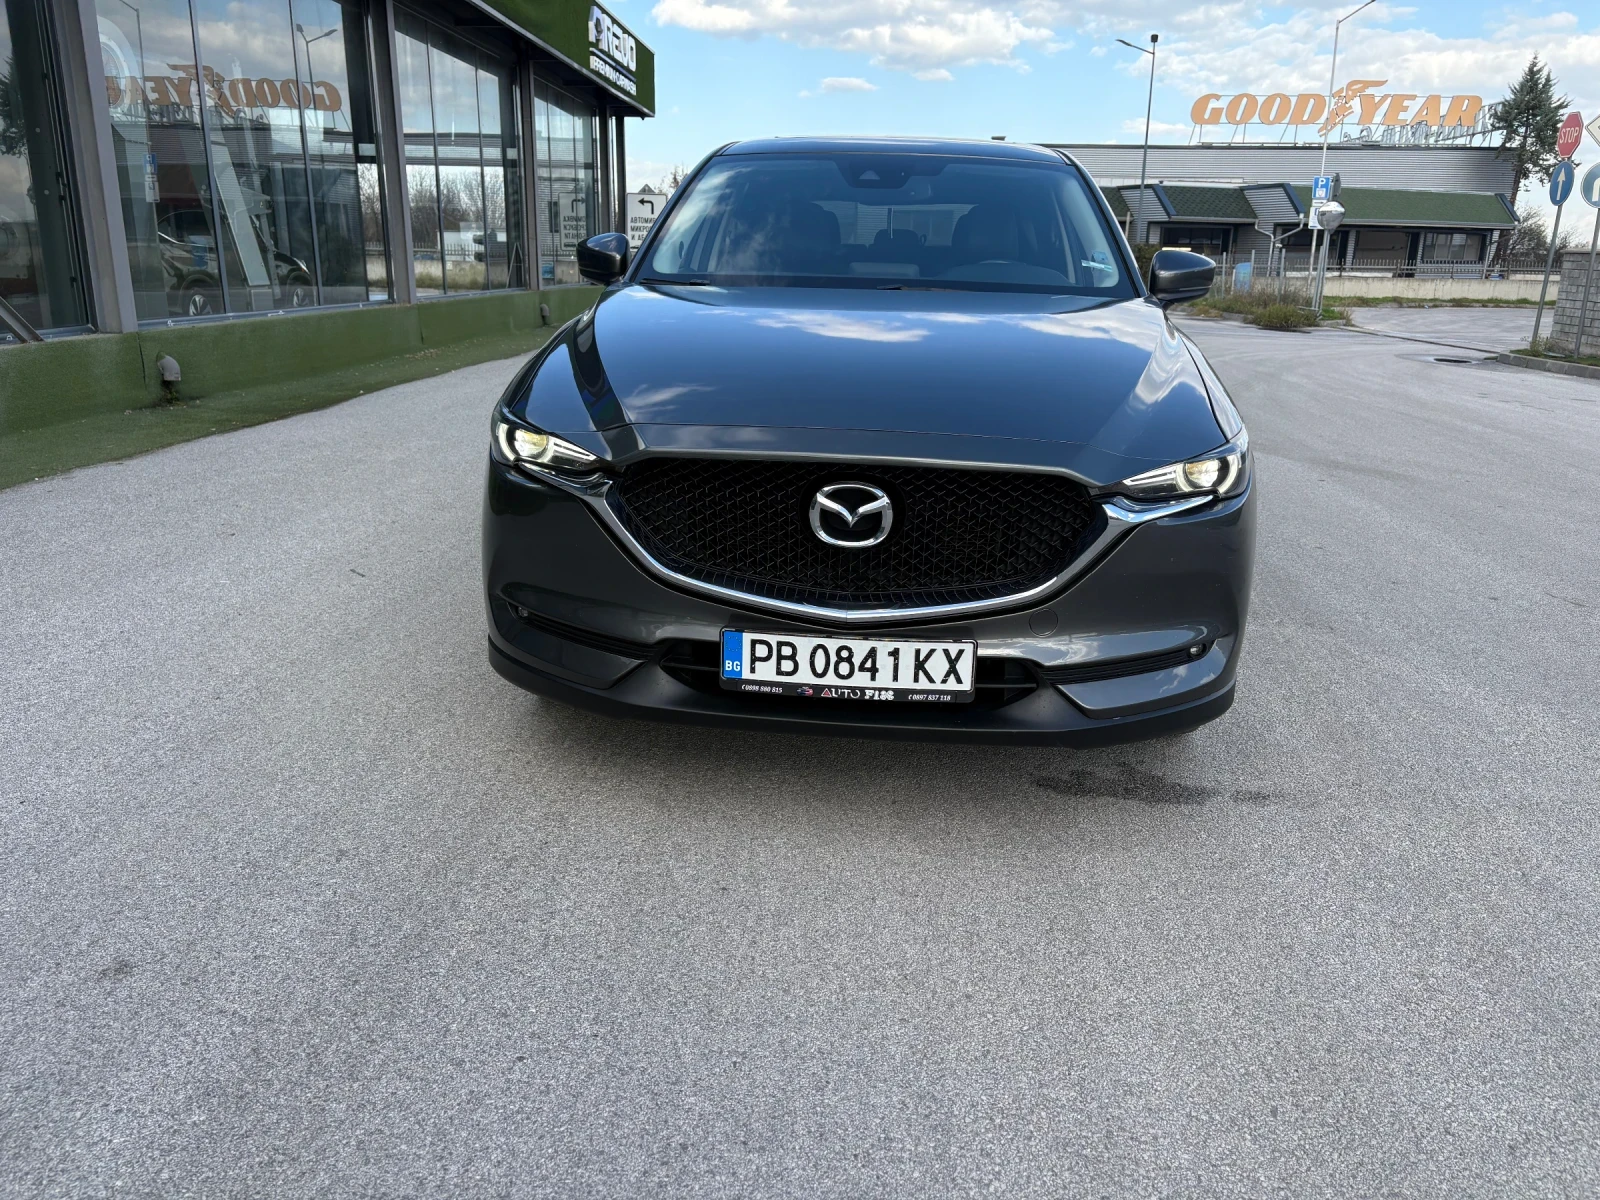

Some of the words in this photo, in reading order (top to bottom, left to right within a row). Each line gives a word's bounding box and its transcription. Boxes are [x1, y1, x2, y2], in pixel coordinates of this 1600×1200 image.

[1559, 127, 1580, 144] STOP
[1318, 177, 1326, 188] P
[630, 225, 651, 233] МИКРО
[725, 660, 741, 672] BG
[749, 638, 800, 677] PB
[809, 643, 900, 683] 0841
[913, 648, 966, 685] KX
